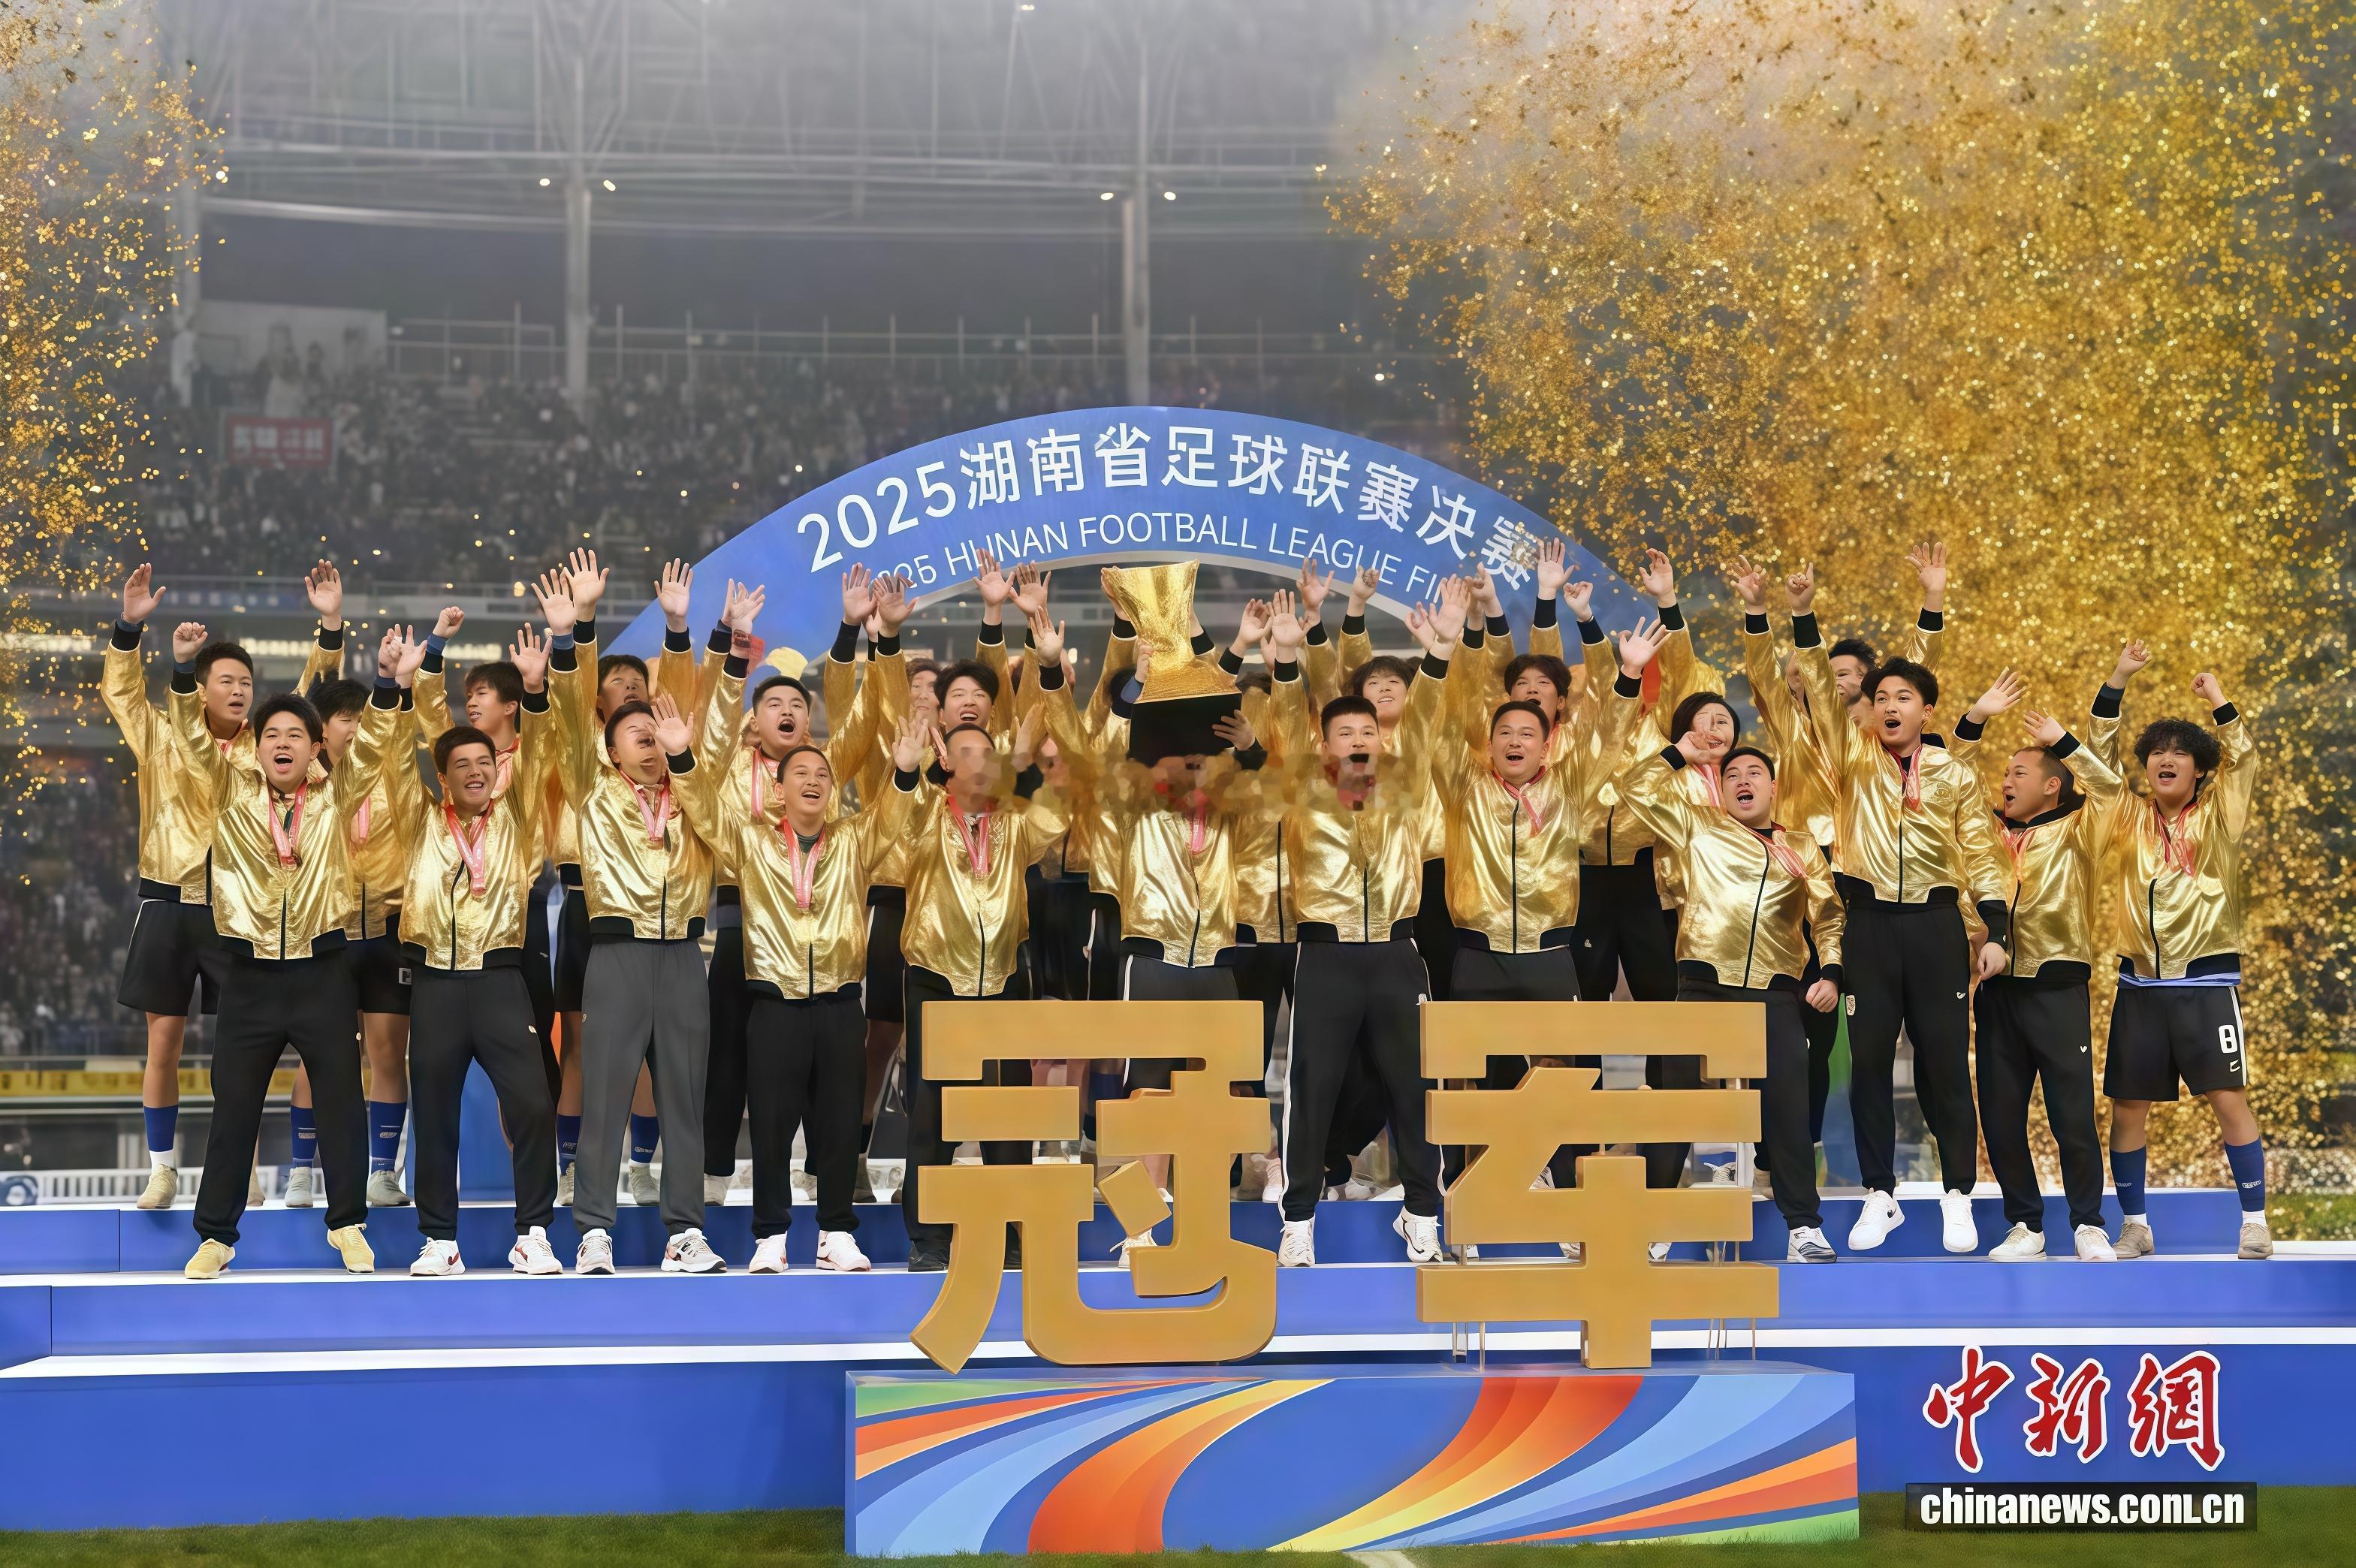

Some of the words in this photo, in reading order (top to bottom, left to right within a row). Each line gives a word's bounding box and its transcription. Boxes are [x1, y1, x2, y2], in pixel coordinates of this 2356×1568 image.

[1078, 511, 1258, 550] FOOTBALL
[1268, 523, 1402, 586] LEAGUE
[2218, 1024, 2238, 1054] 8
[910, 1000, 1780, 1374] 冠军
